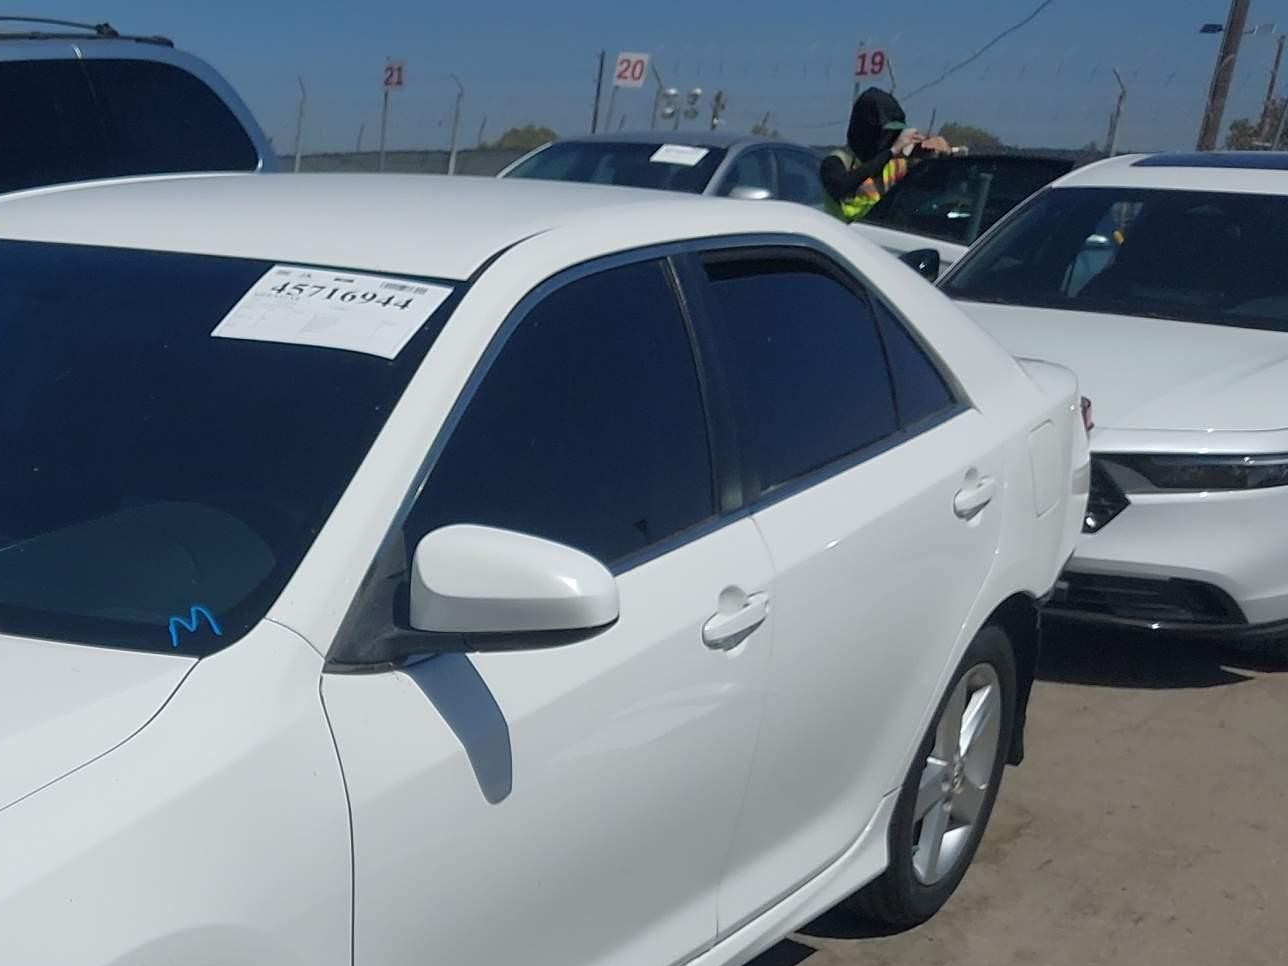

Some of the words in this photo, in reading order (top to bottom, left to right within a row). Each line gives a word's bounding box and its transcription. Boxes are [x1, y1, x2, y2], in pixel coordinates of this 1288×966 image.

[616, 58, 644, 80] 20
[855, 51, 884, 75] 19
[383, 66, 403, 86] 21
[270, 281, 414, 310] 45716944
[168, 606, 223, 647] M
